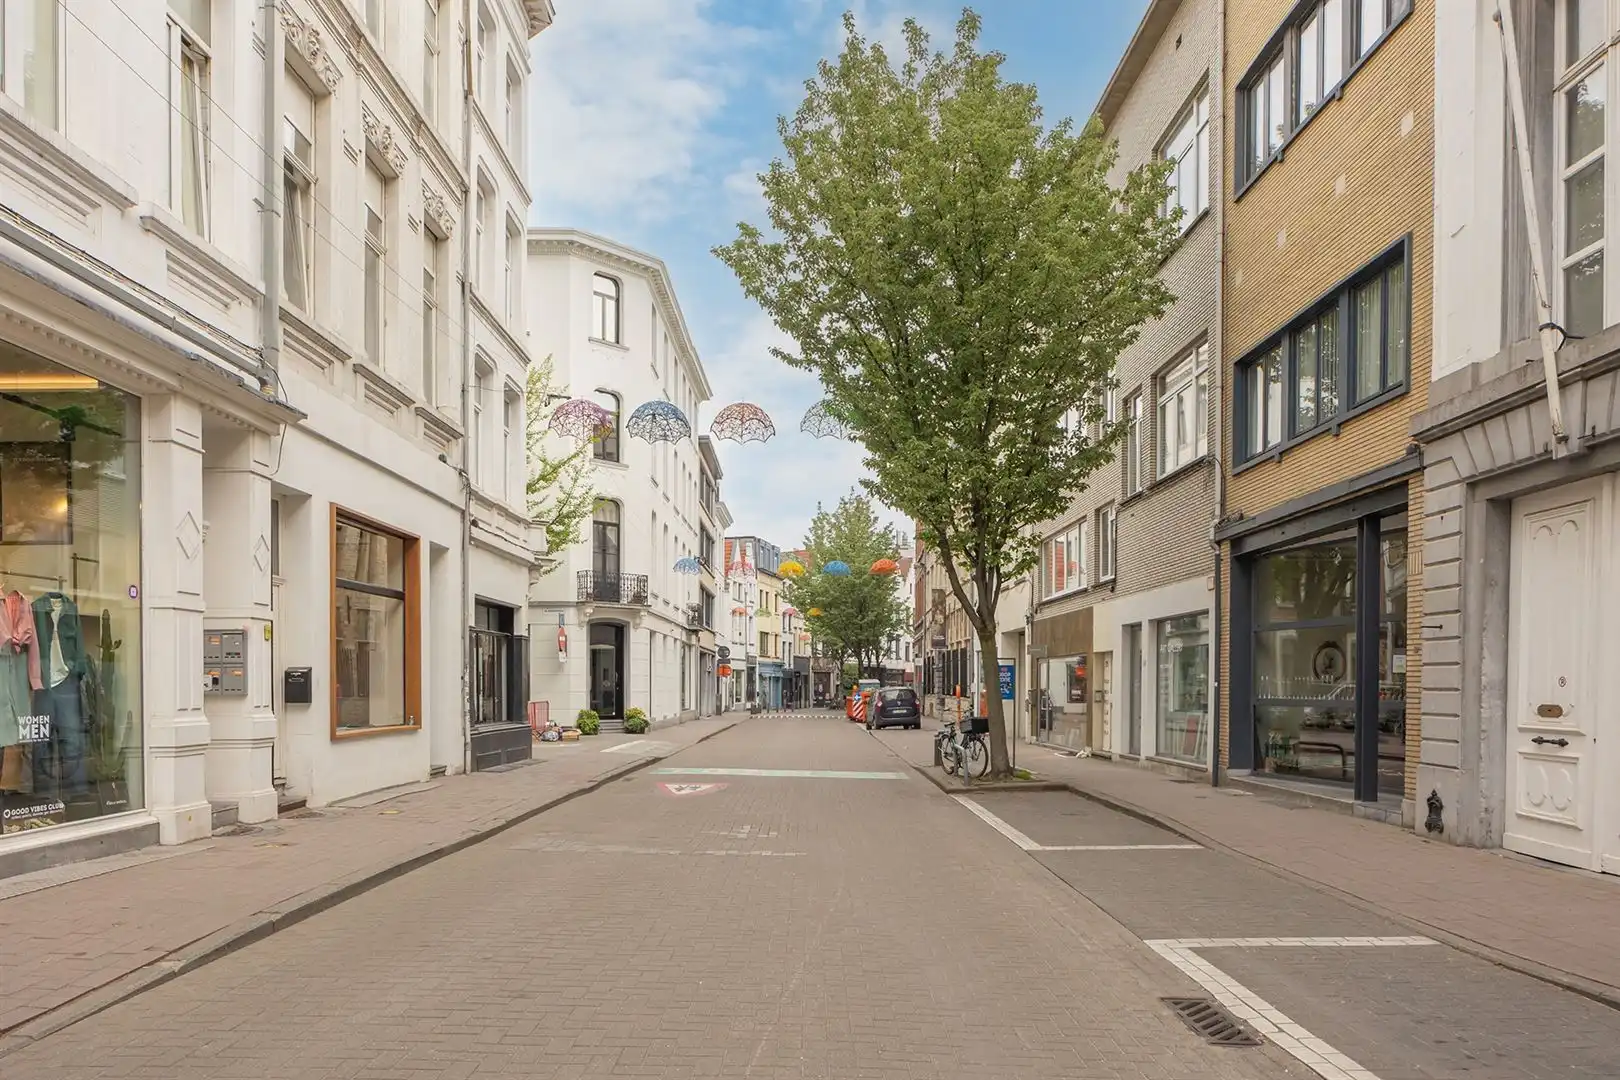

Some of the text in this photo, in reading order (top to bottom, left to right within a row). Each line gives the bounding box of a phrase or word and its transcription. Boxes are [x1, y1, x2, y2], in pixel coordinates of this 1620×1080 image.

[17, 715, 50, 724] WOMEN
[19, 723, 50, 739] MEN
[11, 807, 30, 815] GOOD
[30, 804, 48, 813] VIBES
